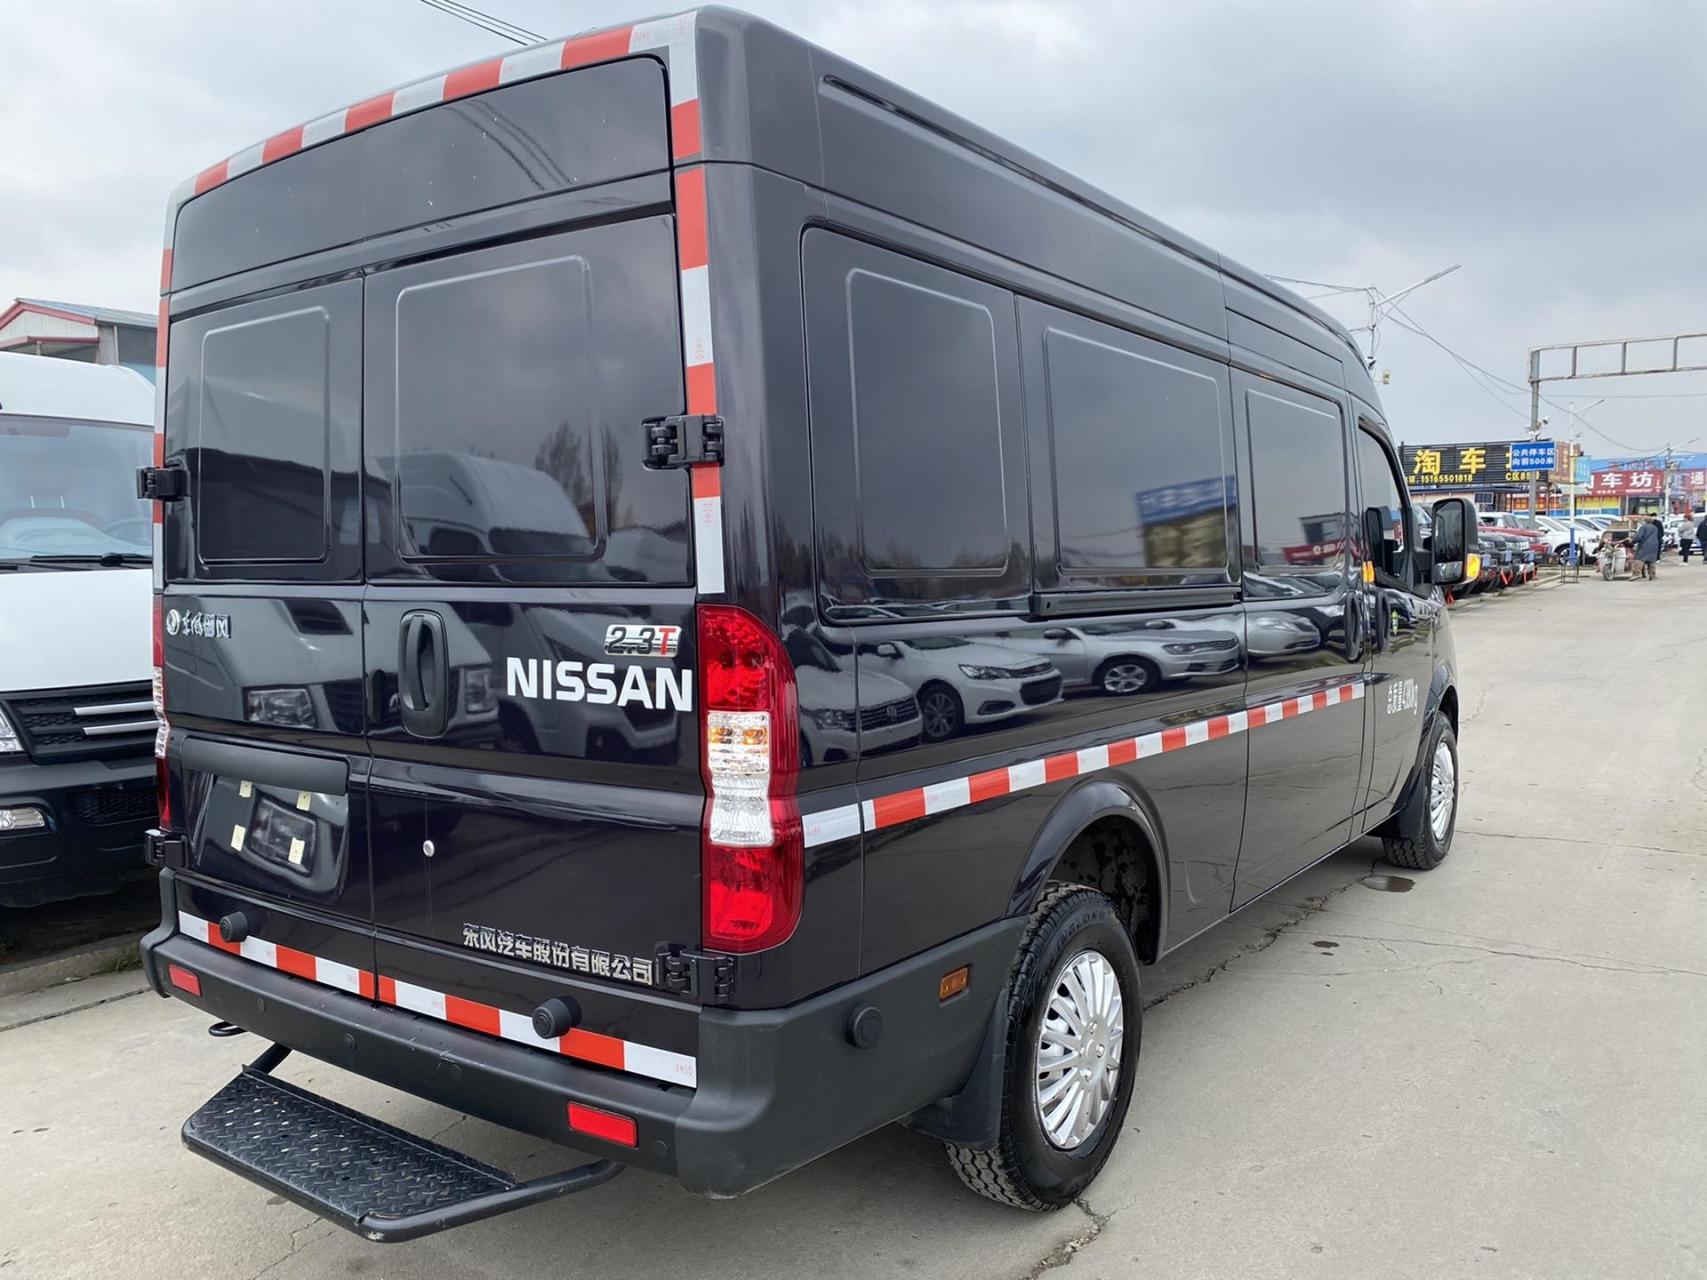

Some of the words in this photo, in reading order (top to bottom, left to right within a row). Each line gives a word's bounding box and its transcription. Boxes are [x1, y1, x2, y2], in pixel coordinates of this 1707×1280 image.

[1512, 448, 1554, 457] 公共停车区
[1512, 457, 1554, 466] 向前500米
[506, 656, 693, 712] NISSAN
[462, 922, 653, 986] 东风汽车股份有限公司
